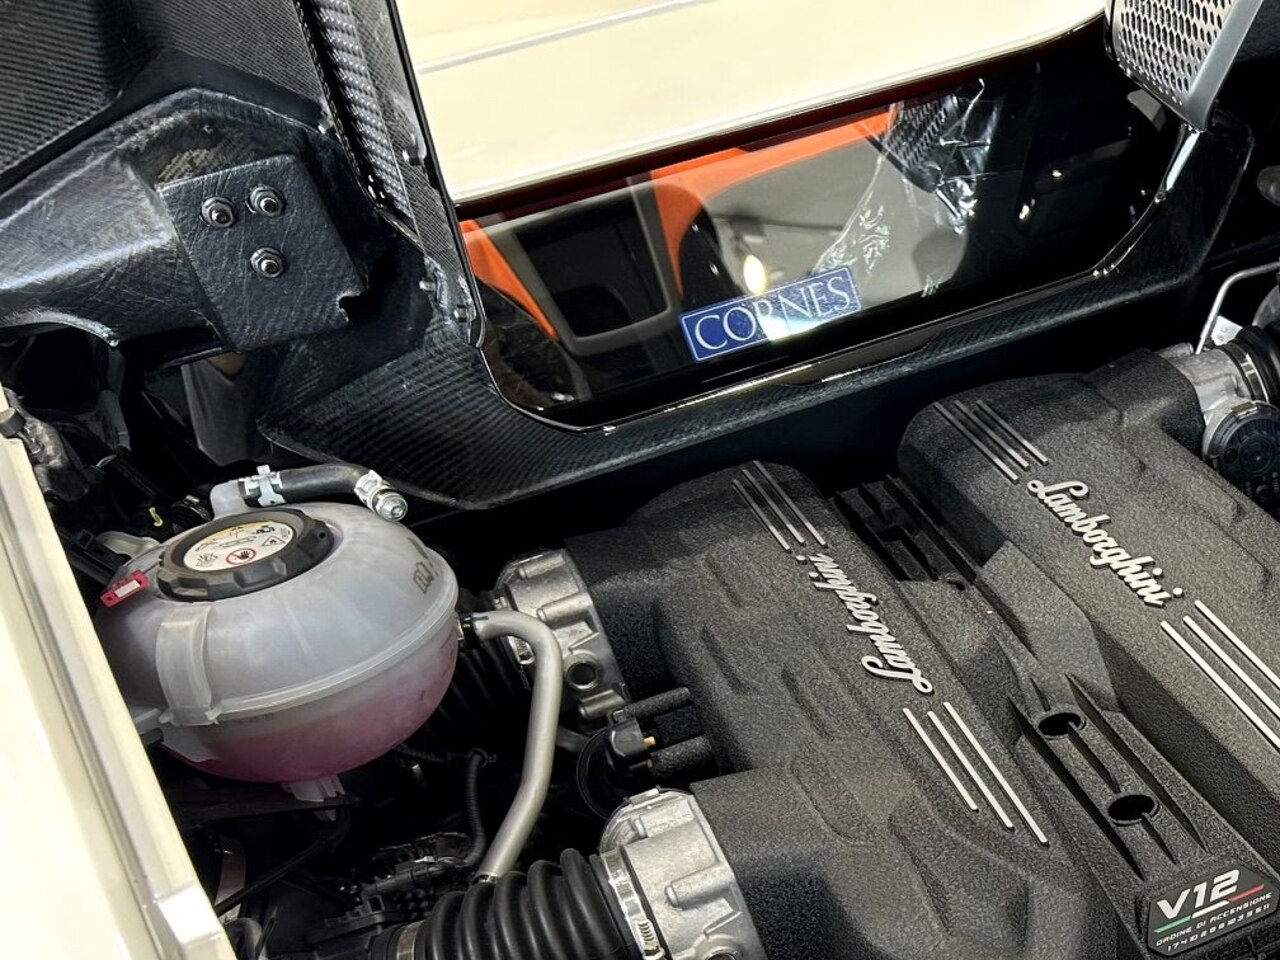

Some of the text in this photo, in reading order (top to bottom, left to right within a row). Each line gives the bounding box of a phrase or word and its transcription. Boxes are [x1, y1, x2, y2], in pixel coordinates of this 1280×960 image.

[694, 276, 851, 350] CORNES
[1027, 479, 1184, 608] Lamborghini
[796, 553, 934, 694] Lamborghini
[1156, 892, 1272, 946] ORDINE DI ACCENSIONE
[1157, 869, 1239, 919] V12
